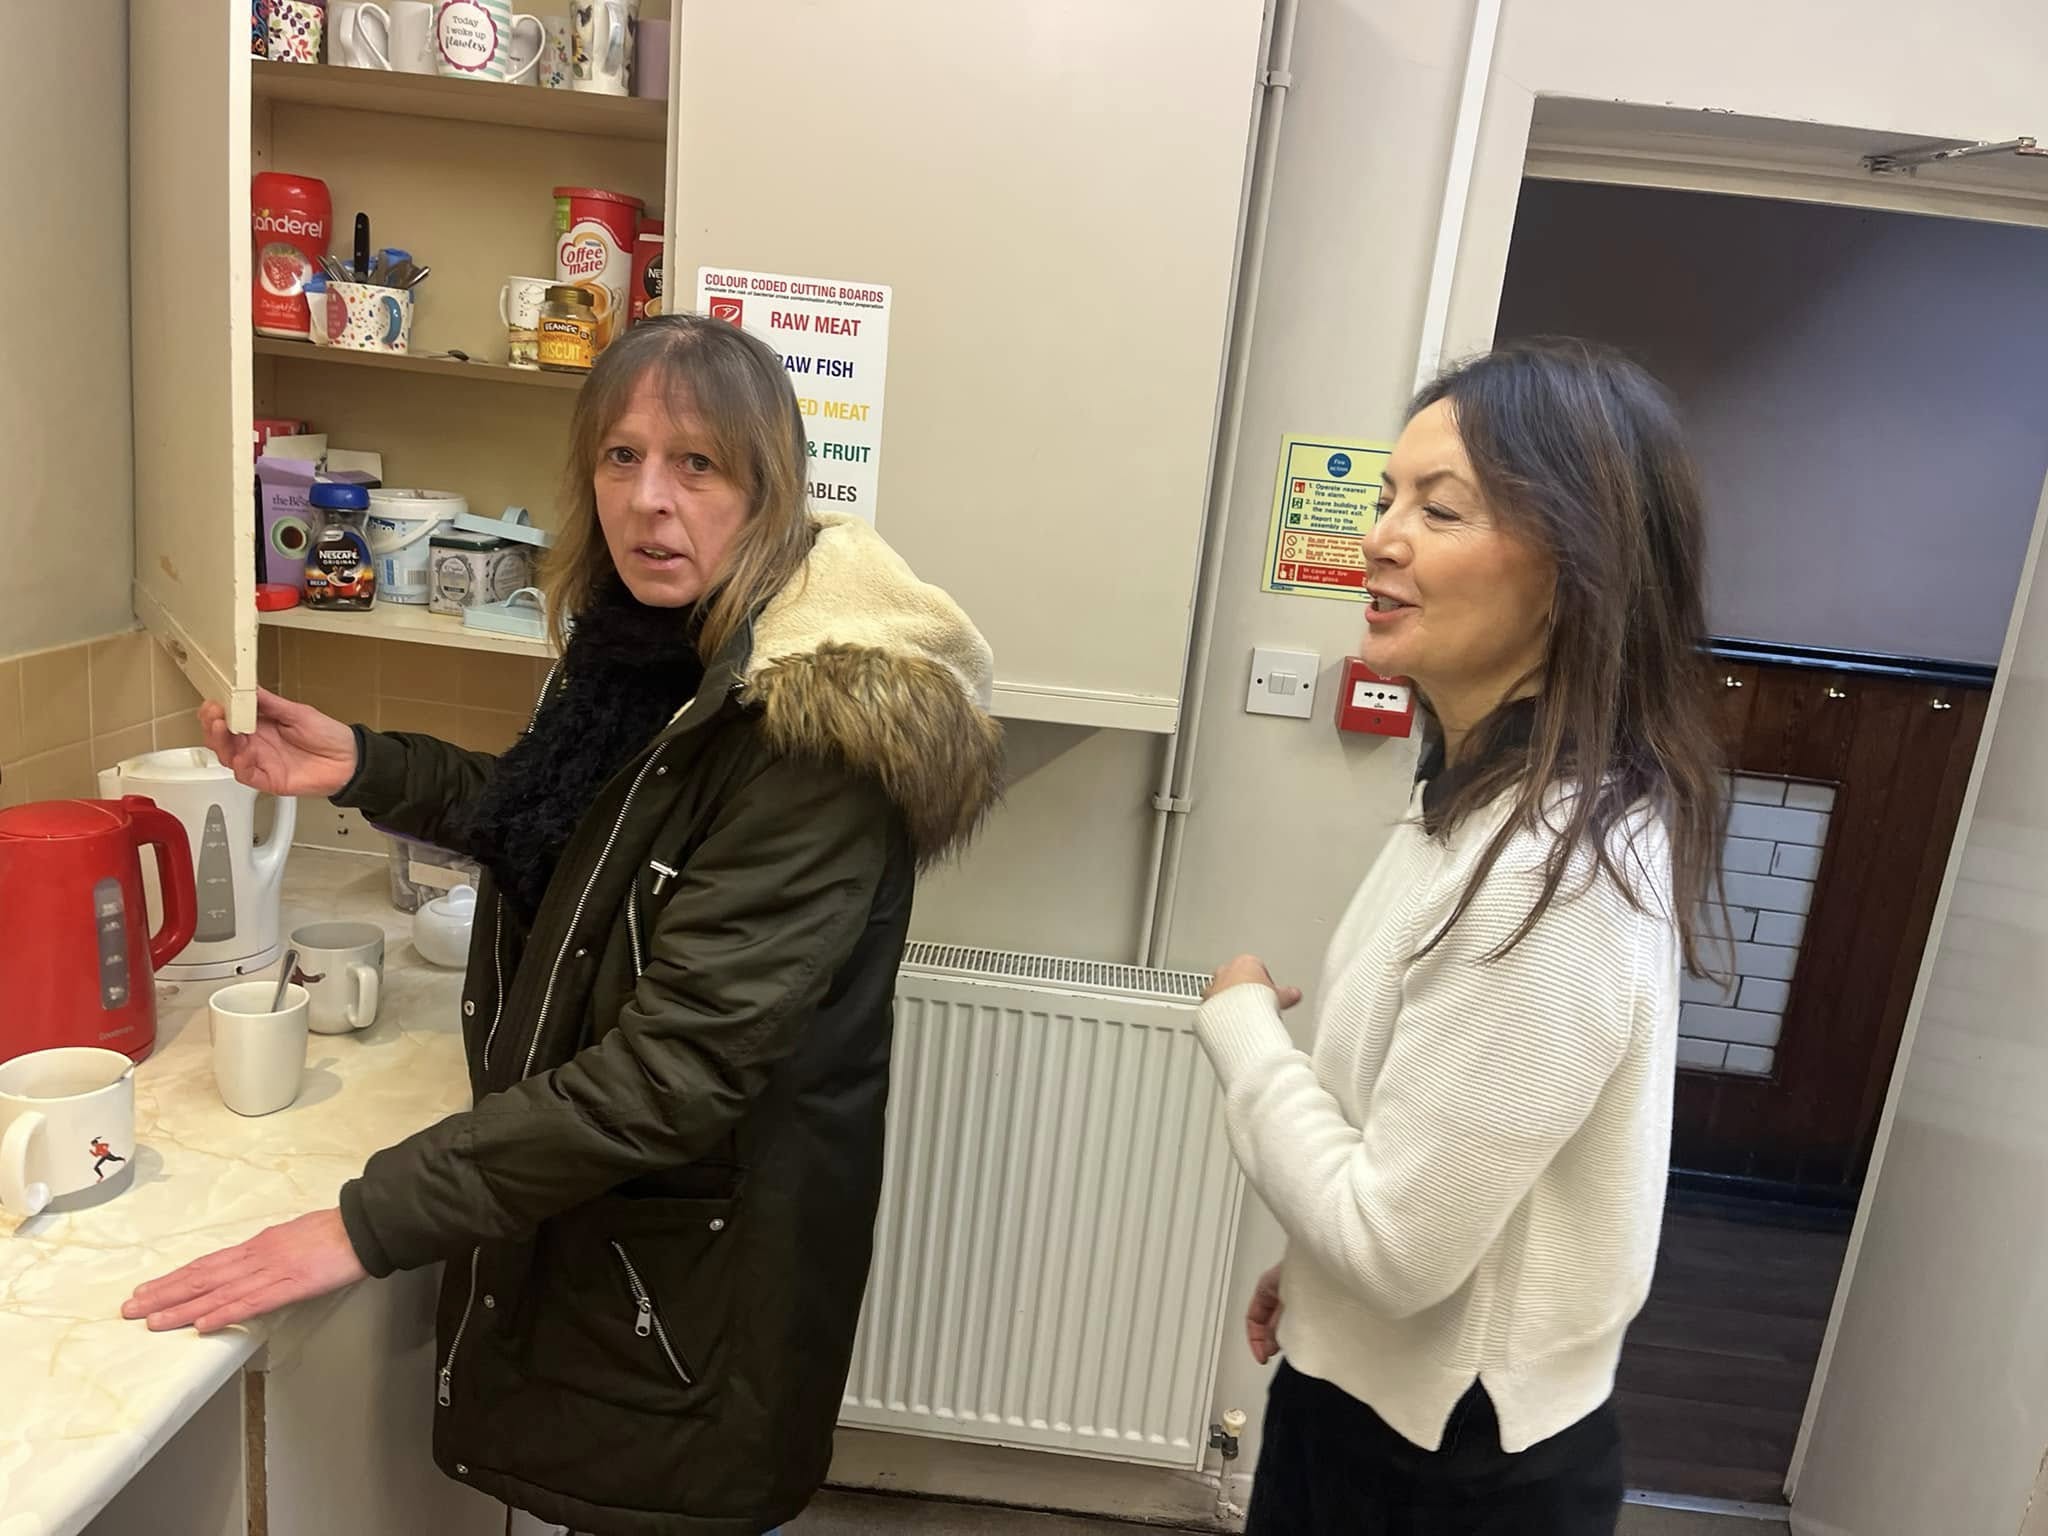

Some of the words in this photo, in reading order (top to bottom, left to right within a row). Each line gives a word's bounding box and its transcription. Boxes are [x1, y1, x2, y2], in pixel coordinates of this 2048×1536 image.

[452, 15, 479, 28] Today
[451, 27, 473, 37] woke
[475, 31, 486, 40] up
[445, 36, 486, 52] flawless
[253, 213, 323, 238] anderel
[561, 242, 603, 267] Coffee
[569, 260, 603, 276] mate
[705, 273, 748, 289] COLOUR
[751, 278, 787, 293] CODED
[791, 282, 836, 298] CUTTING
[839, 287, 884, 303] BOARDS
[770, 311, 810, 332] RAW
[815, 315, 861, 337] MEAT
[816, 358, 853, 379] FISH
[798, 398, 818, 417] ED
[824, 401, 870, 422] MEAT
[823, 442, 871, 463] FRUIT
[1334, 458, 1345, 466] Fire
[807, 482, 857, 502] ABLES
[1315, 483, 1341, 492] Operate
[1343, 486, 1367, 494] nearest
[272, 494, 288, 505] the
[1313, 499, 1332, 507] Leave
[1333, 501, 1358, 510] building
[1311, 514, 1333, 523] Report
[1325, 507, 1349, 516] nearest
[1310, 522, 1340, 531] assembly
